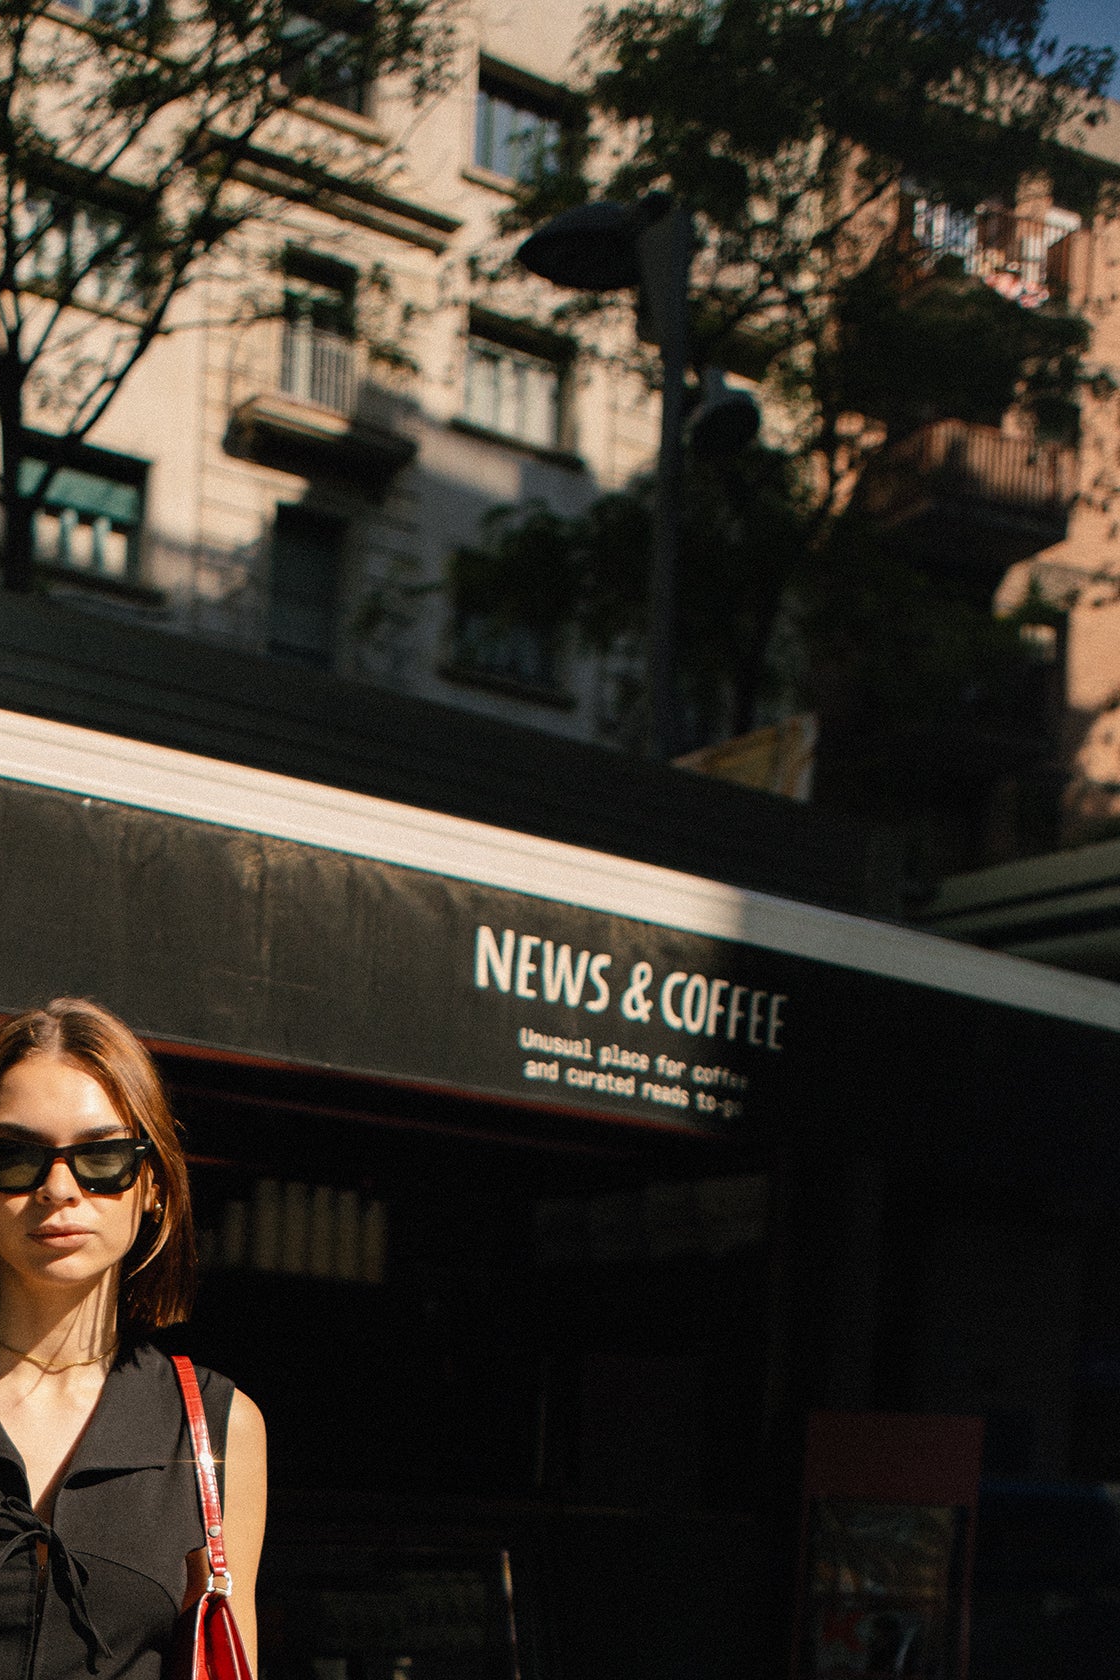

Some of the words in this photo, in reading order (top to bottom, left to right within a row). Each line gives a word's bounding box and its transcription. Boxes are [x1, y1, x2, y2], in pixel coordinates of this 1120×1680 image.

[475, 926, 612, 1014] NEWS
[620, 962, 654, 1023] &
[661, 971, 787, 1050] COFFEE
[518, 1027, 593, 1062] Unusual
[597, 1043, 650, 1073] place
[654, 1054, 687, 1079] for
[523, 1060, 560, 1083] and
[564, 1066, 636, 1098] curated
[640, 1081, 690, 1109] reads
